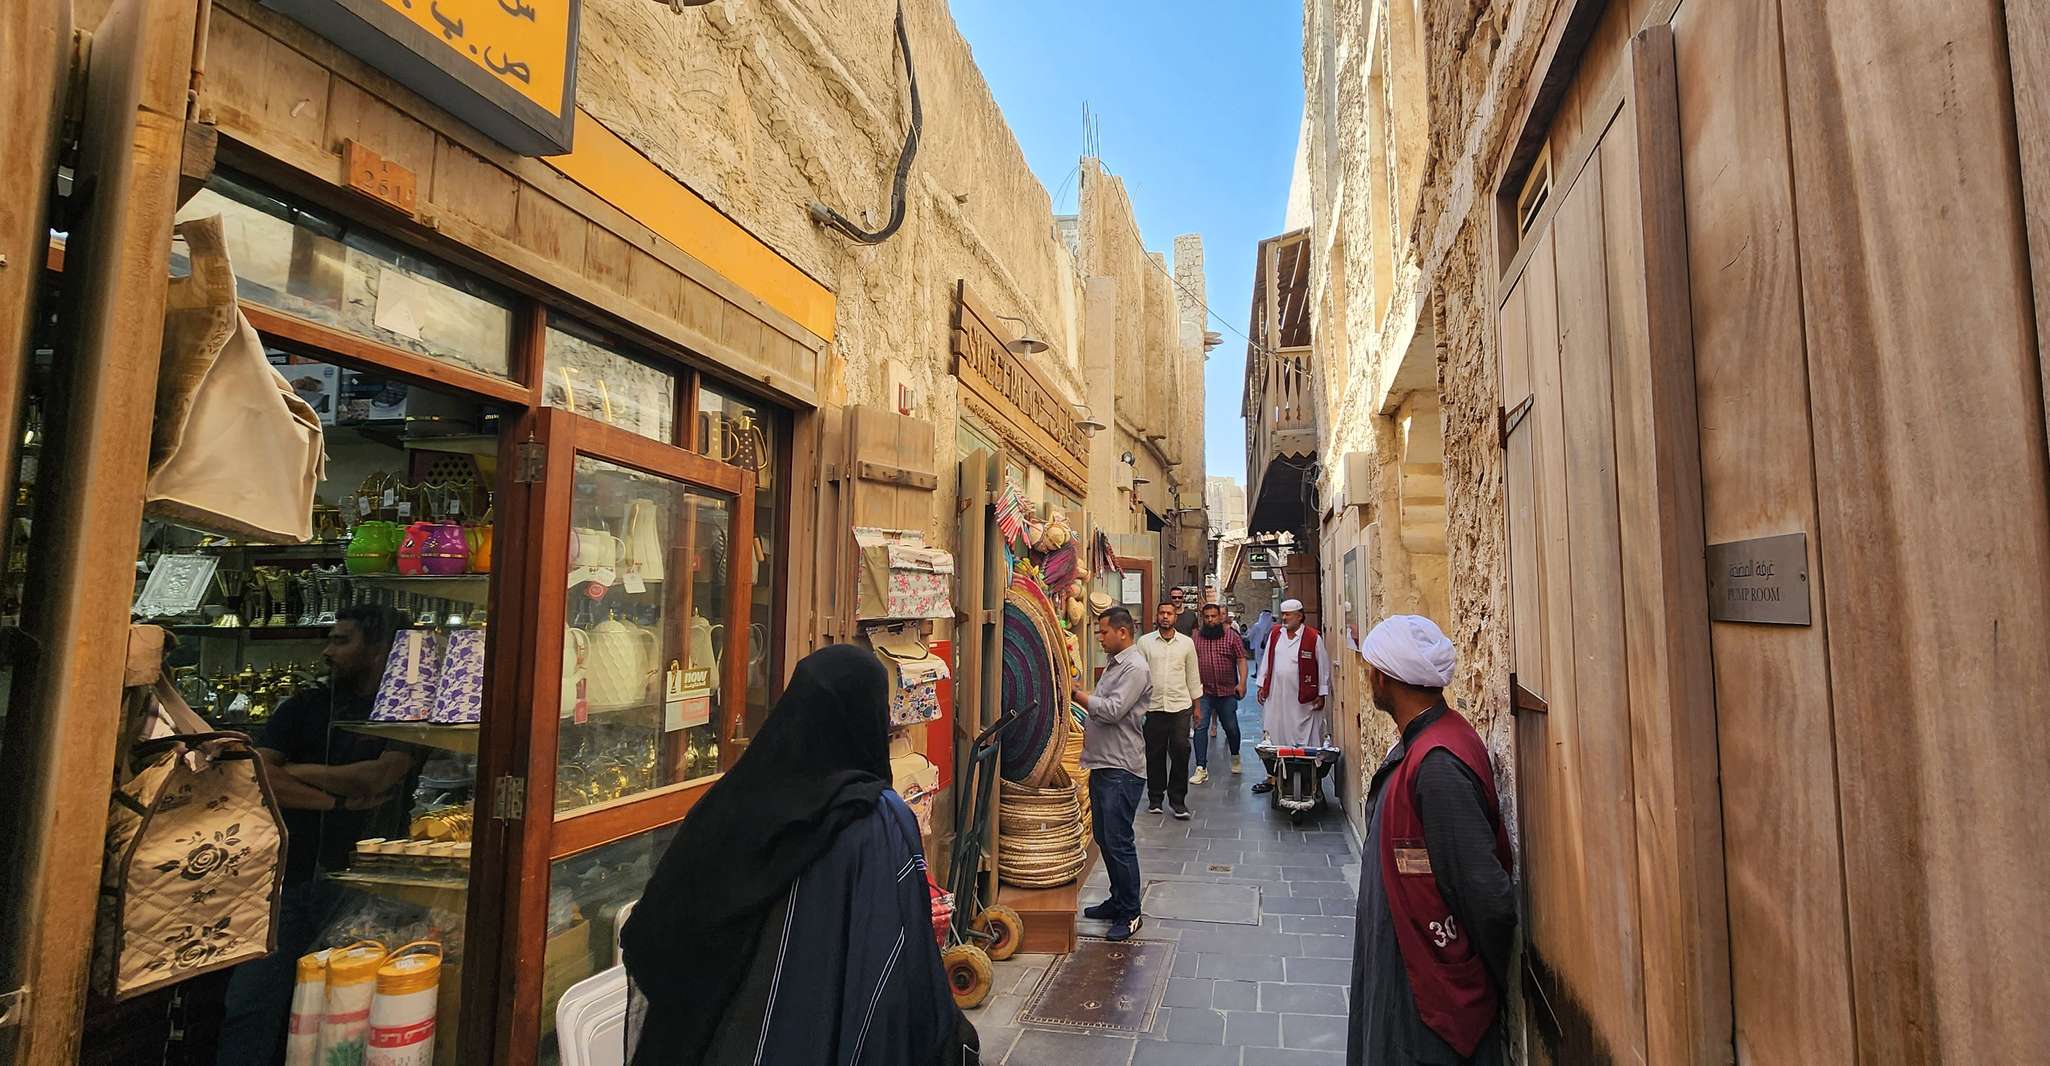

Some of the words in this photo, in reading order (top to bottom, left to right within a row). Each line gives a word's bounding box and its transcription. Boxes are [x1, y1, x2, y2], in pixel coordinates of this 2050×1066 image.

[967, 325, 1010, 400] SWEET
[1728, 587, 1750, 601] PUMP
[1751, 586, 1780, 602] ROOM
[1429, 915, 1457, 947] 30
